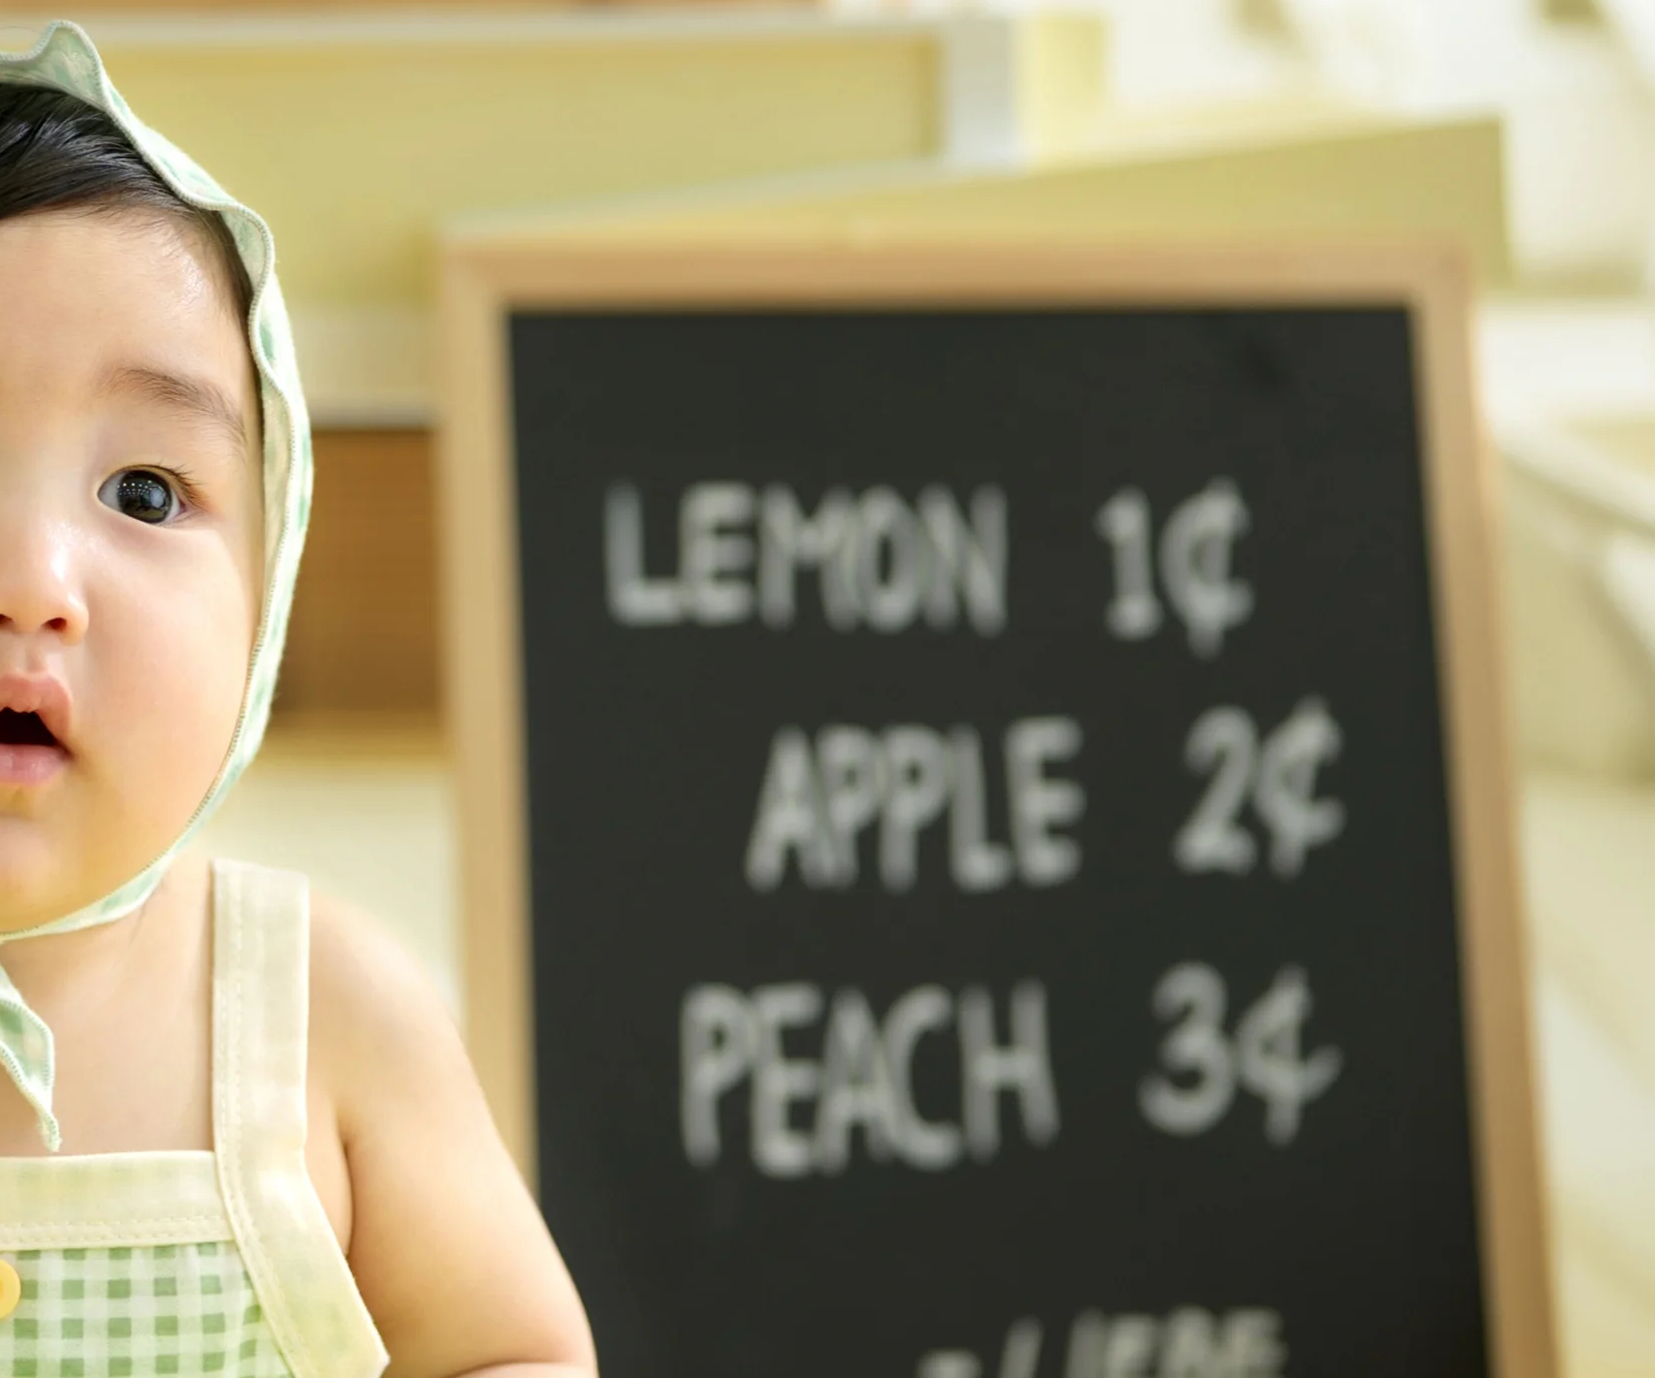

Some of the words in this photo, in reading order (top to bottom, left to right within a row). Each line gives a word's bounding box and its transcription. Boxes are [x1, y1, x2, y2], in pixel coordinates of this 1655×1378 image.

[605, 482, 1007, 634] LEMON
[1096, 478, 1253, 655] 1¢
[745, 716, 1084, 891] APPLE
[1175, 697, 1343, 874] 2¢
[680, 980, 1059, 1177] PEACH
[1141, 963, 1340, 1142] 3¢
